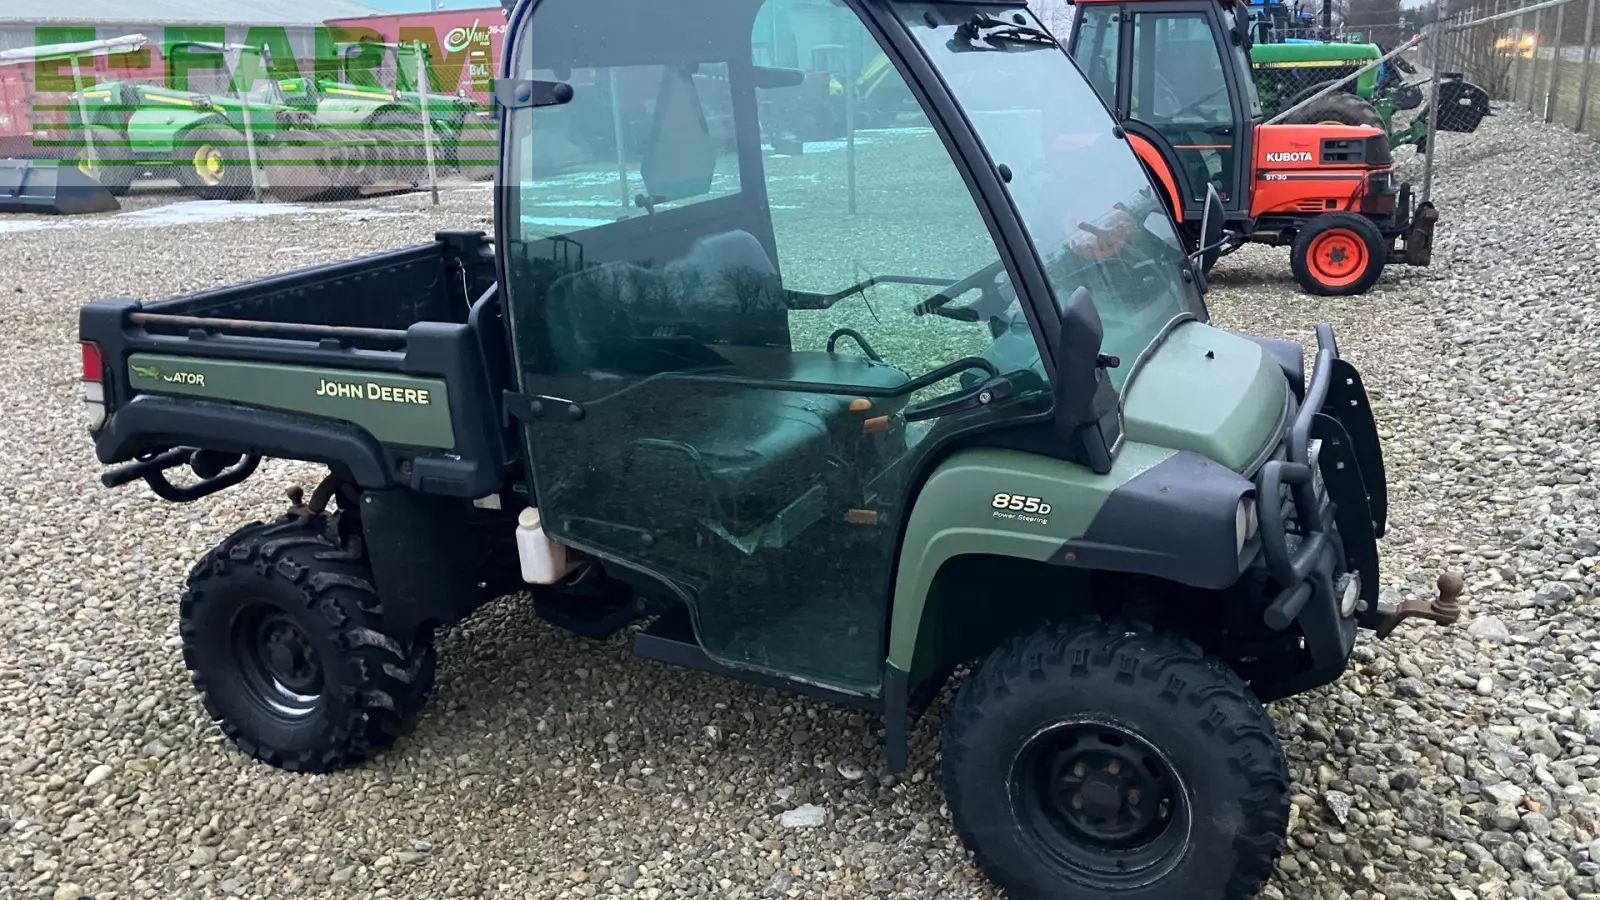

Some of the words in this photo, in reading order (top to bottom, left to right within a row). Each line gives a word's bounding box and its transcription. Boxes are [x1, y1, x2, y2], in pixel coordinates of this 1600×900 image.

[1266, 151, 1313, 162] KUBOTA
[992, 492, 1051, 515] 855D
[992, 511, 1016, 519] Power
[1017, 514, 1048, 525] Steering
